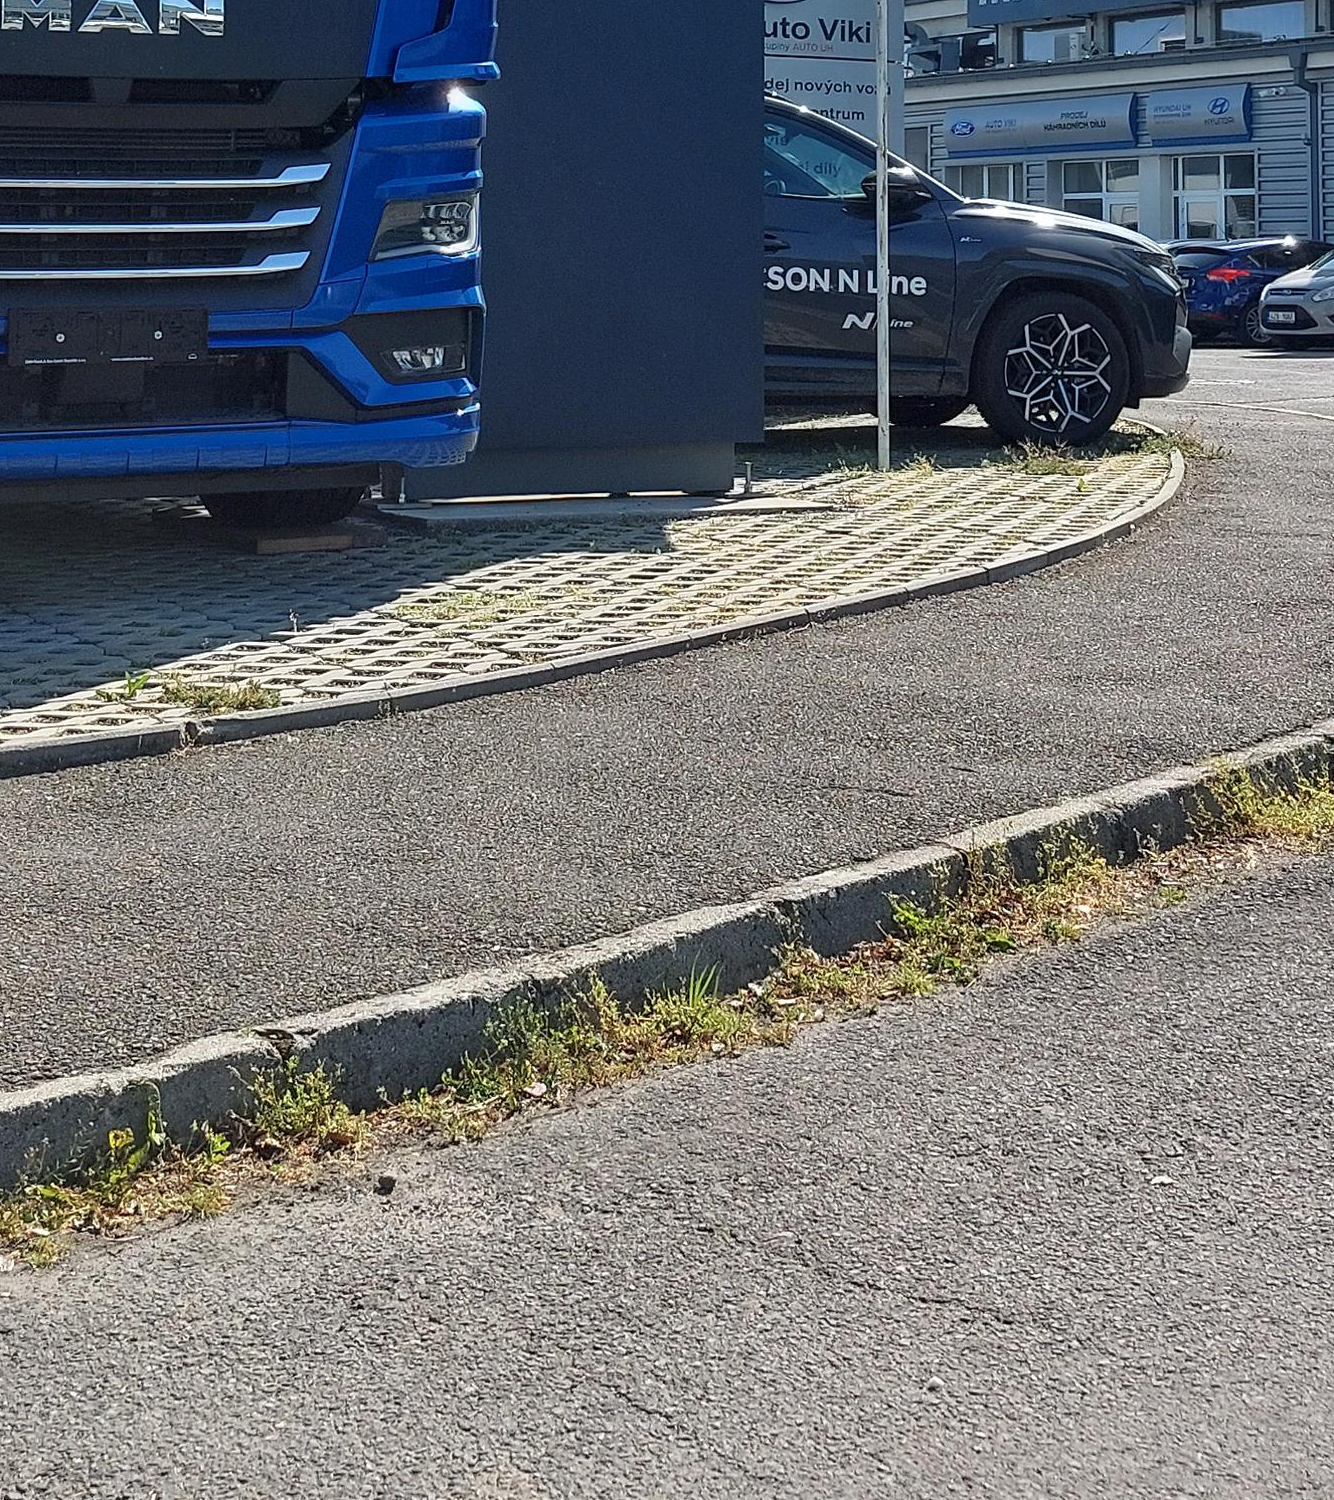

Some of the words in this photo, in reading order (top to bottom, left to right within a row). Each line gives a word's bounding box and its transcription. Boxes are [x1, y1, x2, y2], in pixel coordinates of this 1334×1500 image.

[818, 18, 872, 43] Viki
[792, 42, 819, 52] AUTO
[794, 80, 853, 96] nových
[764, 265, 831, 293] SON
[838, 268, 859, 294] N
[841, 312, 875, 330] N
